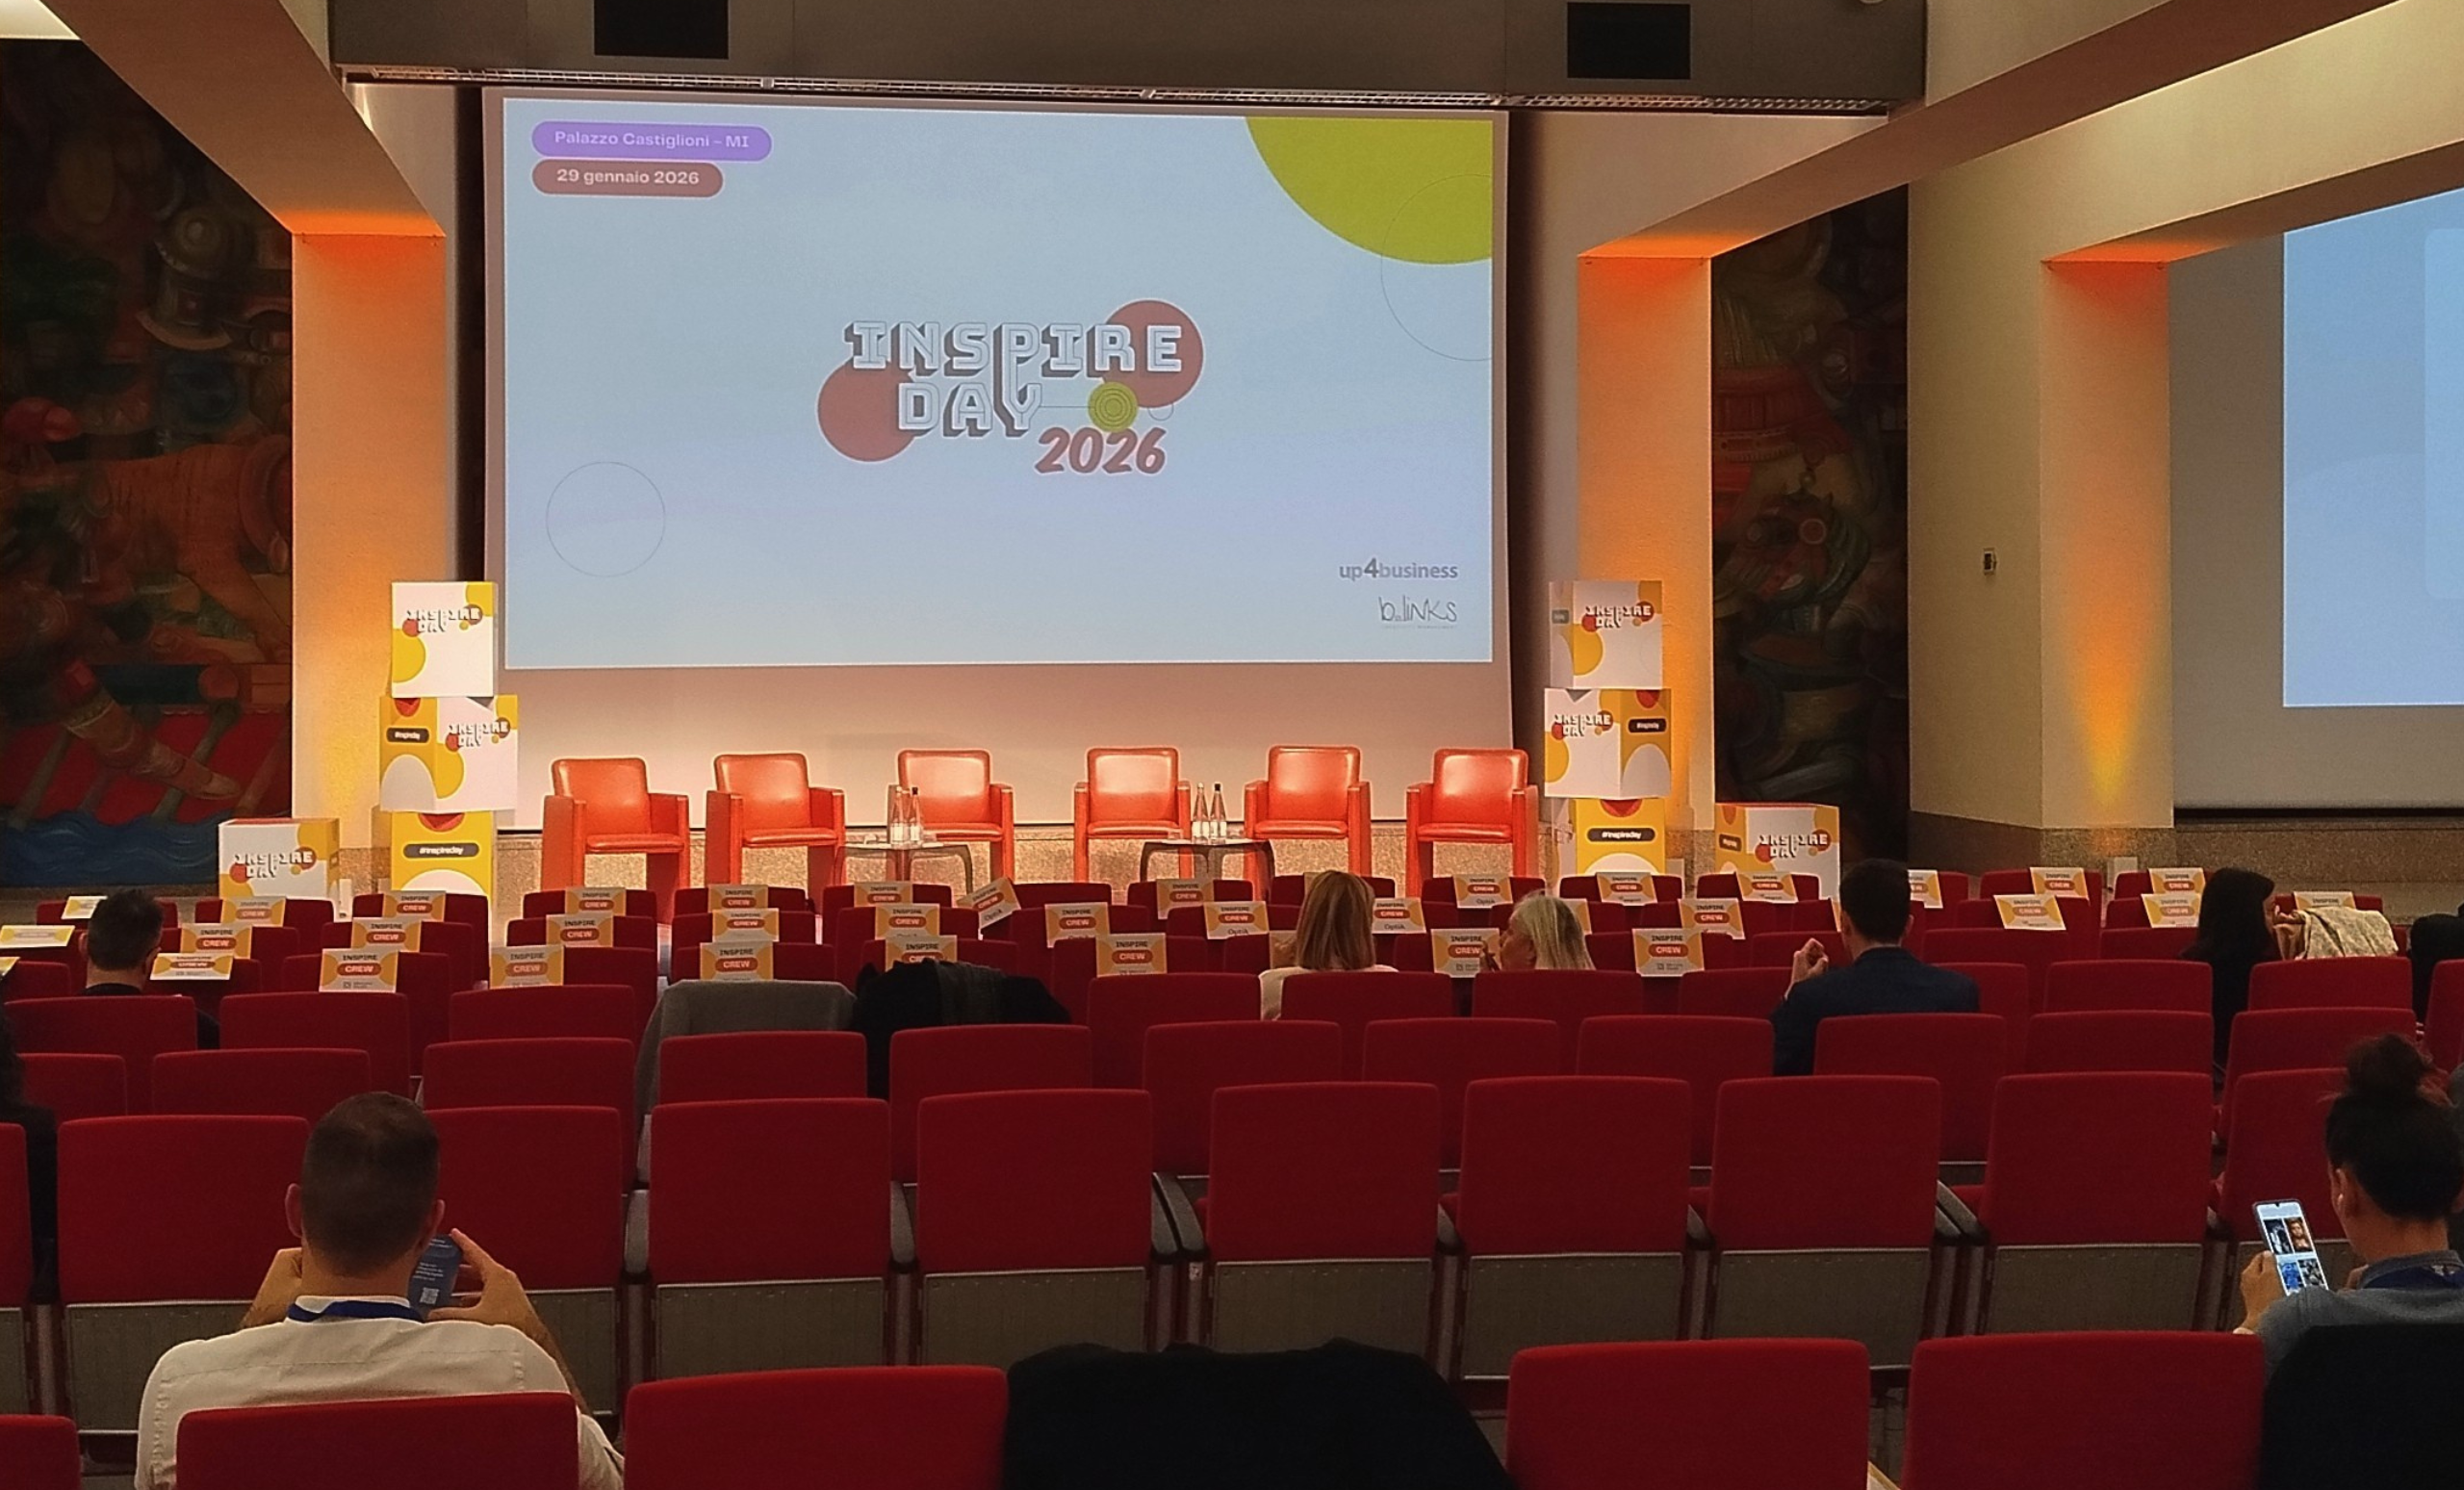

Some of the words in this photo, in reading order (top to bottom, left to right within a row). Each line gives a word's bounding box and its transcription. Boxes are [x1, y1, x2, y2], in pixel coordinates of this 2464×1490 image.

[554, 130, 619, 144] Palazzo
[623, 132, 710, 149] Castiglioni
[726, 135, 750, 148] MI
[556, 168, 580, 182] 29
[583, 168, 651, 186] gennaio
[654, 171, 701, 185] 2026
[844, 321, 1183, 378] INSPIRE
[898, 382, 1043, 438] DAY
[1034, 426, 1168, 475] 2026
[1339, 557, 1459, 581] up4business
[406, 607, 481, 621] INSPIRE
[1585, 604, 1653, 617] INSPIRE
[449, 720, 509, 735] INSPIRE
[1553, 713, 1612, 727] INSPIRE
[1759, 833, 1829, 846] INSPIRE
[234, 851, 314, 866] INSPIRE
[372, 933, 398, 941] CREW
[513, 964, 541, 973] CREW
